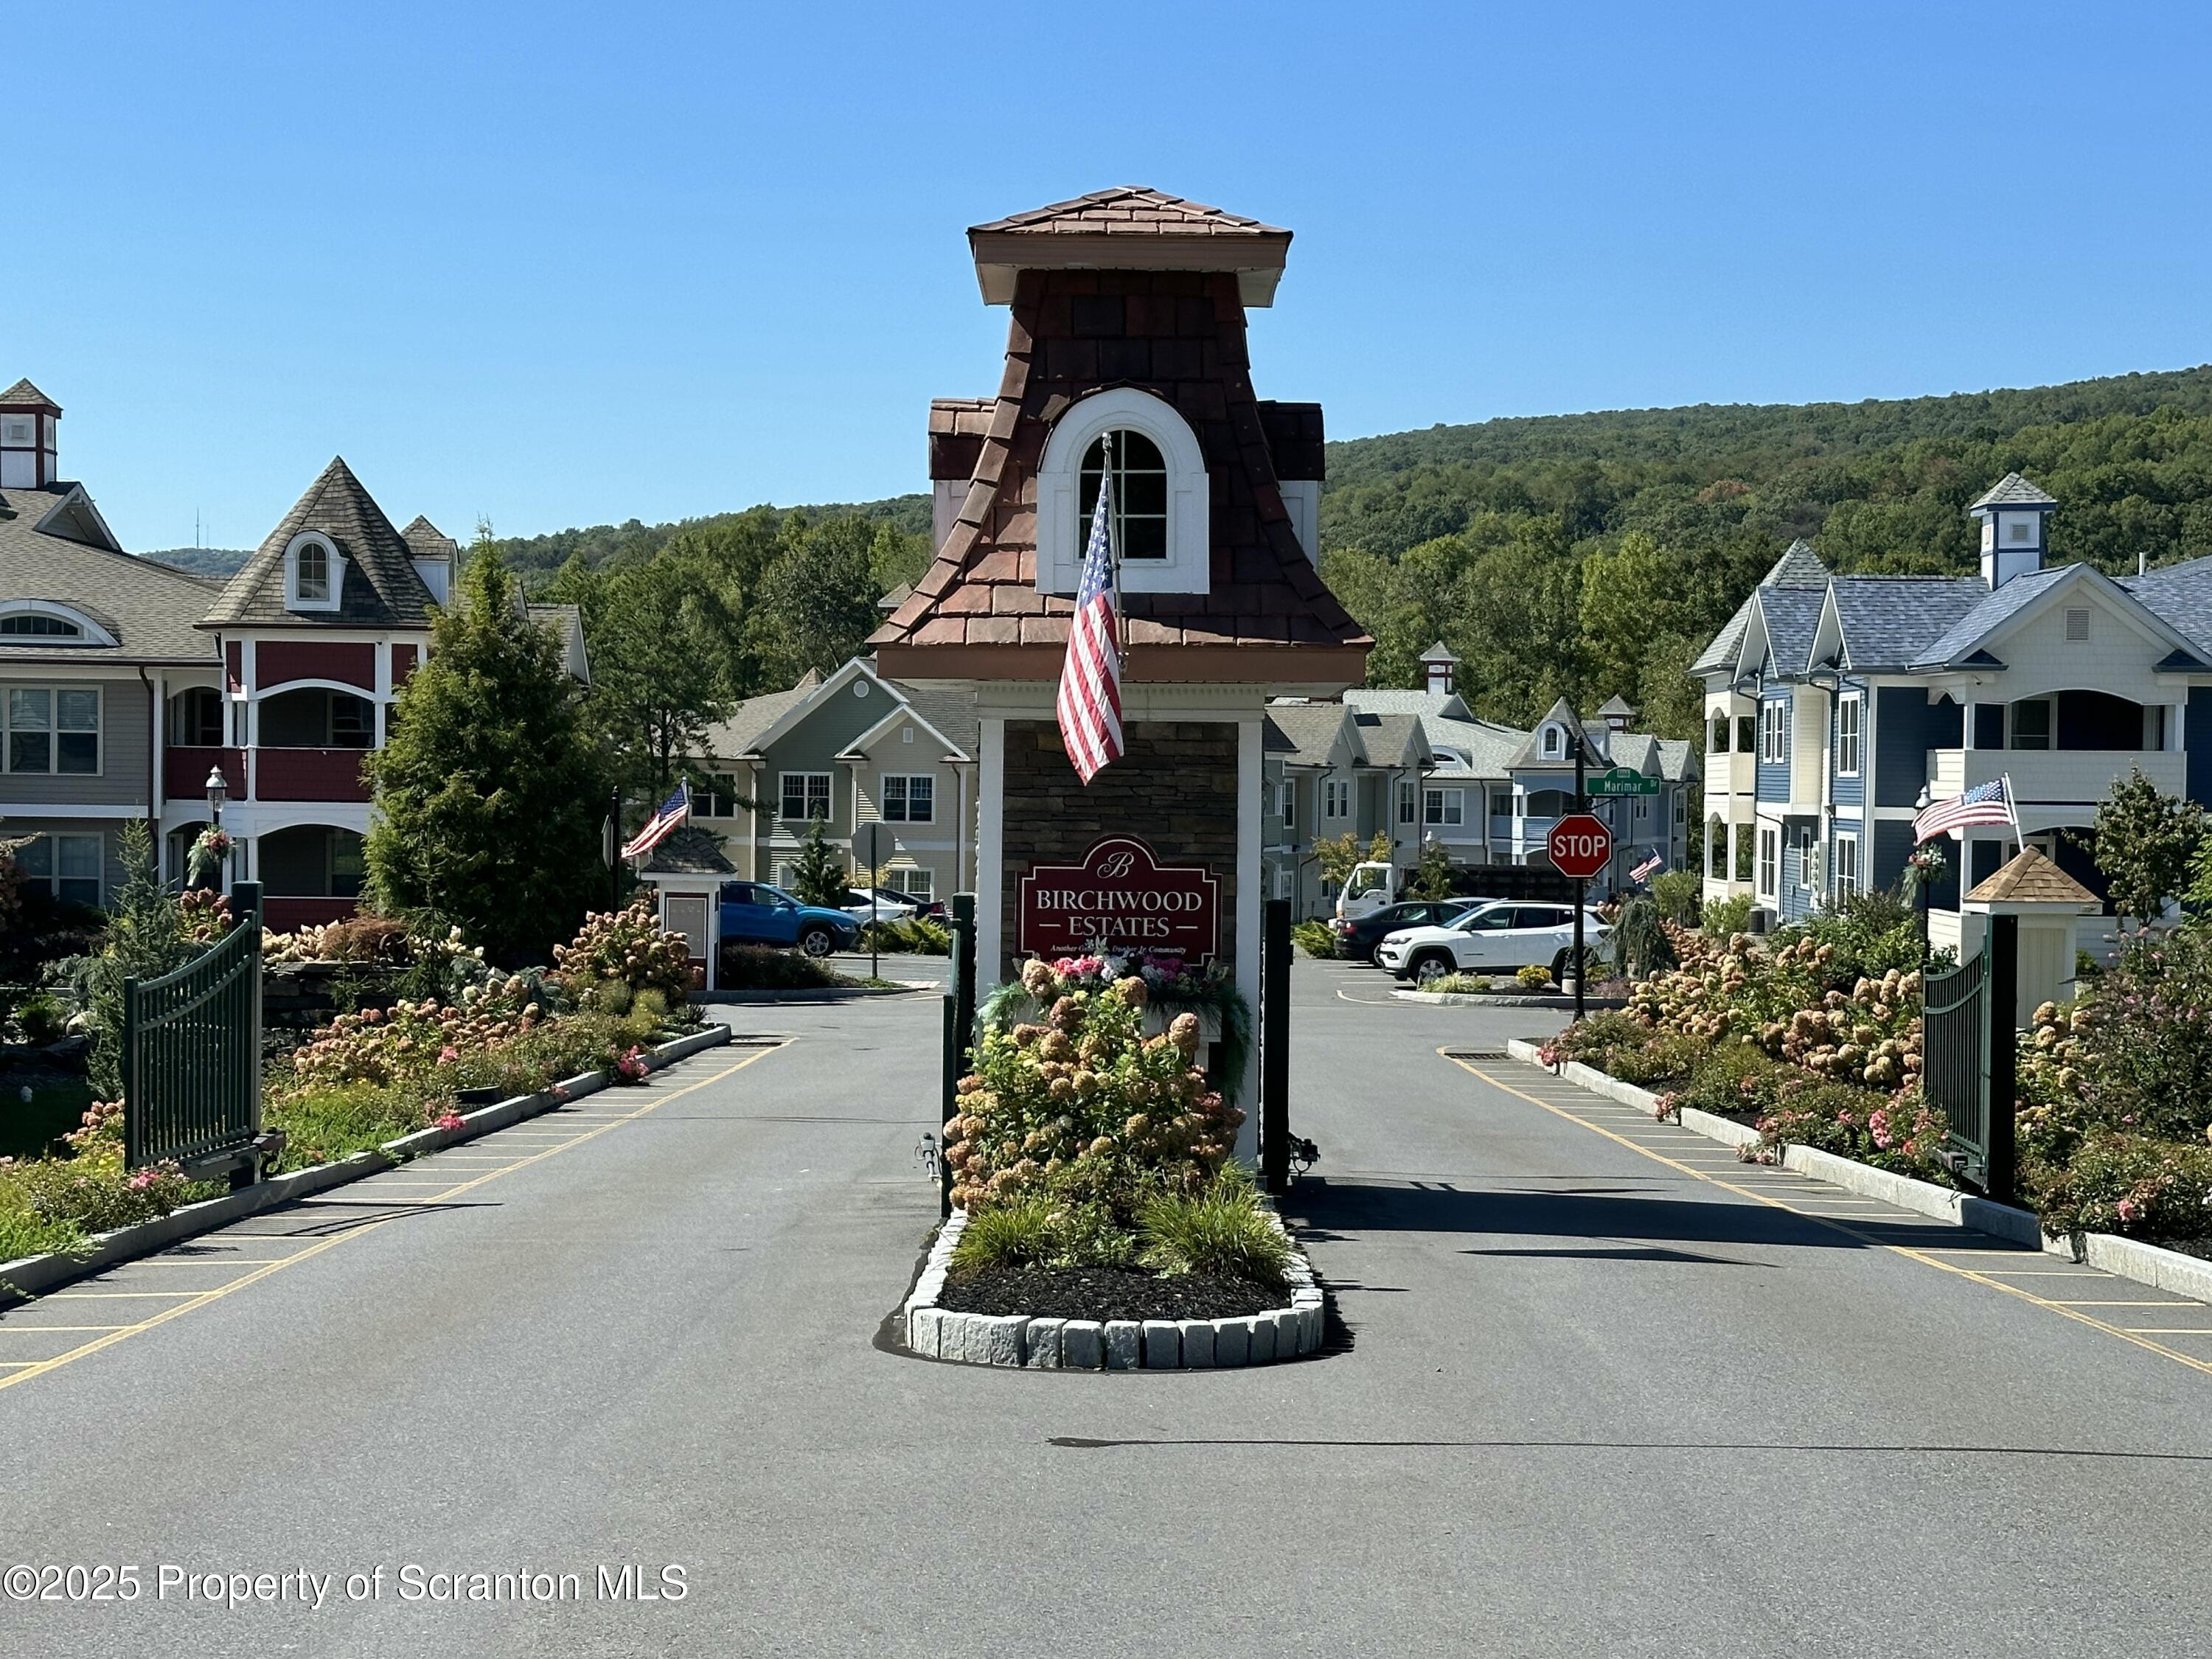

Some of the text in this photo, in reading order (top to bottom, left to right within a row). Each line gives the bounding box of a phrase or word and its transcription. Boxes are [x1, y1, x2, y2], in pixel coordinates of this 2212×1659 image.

[1604, 779, 1658, 792] Marimar Dr
[1554, 835, 1606, 858] STOP
[1096, 852, 1135, 879] B
[1035, 890, 1203, 911] BIRCHWOOD
[1068, 916, 1170, 937] ESTATES
[1050, 945, 1077, 953] Another
[1149, 946, 1186, 955] Community
